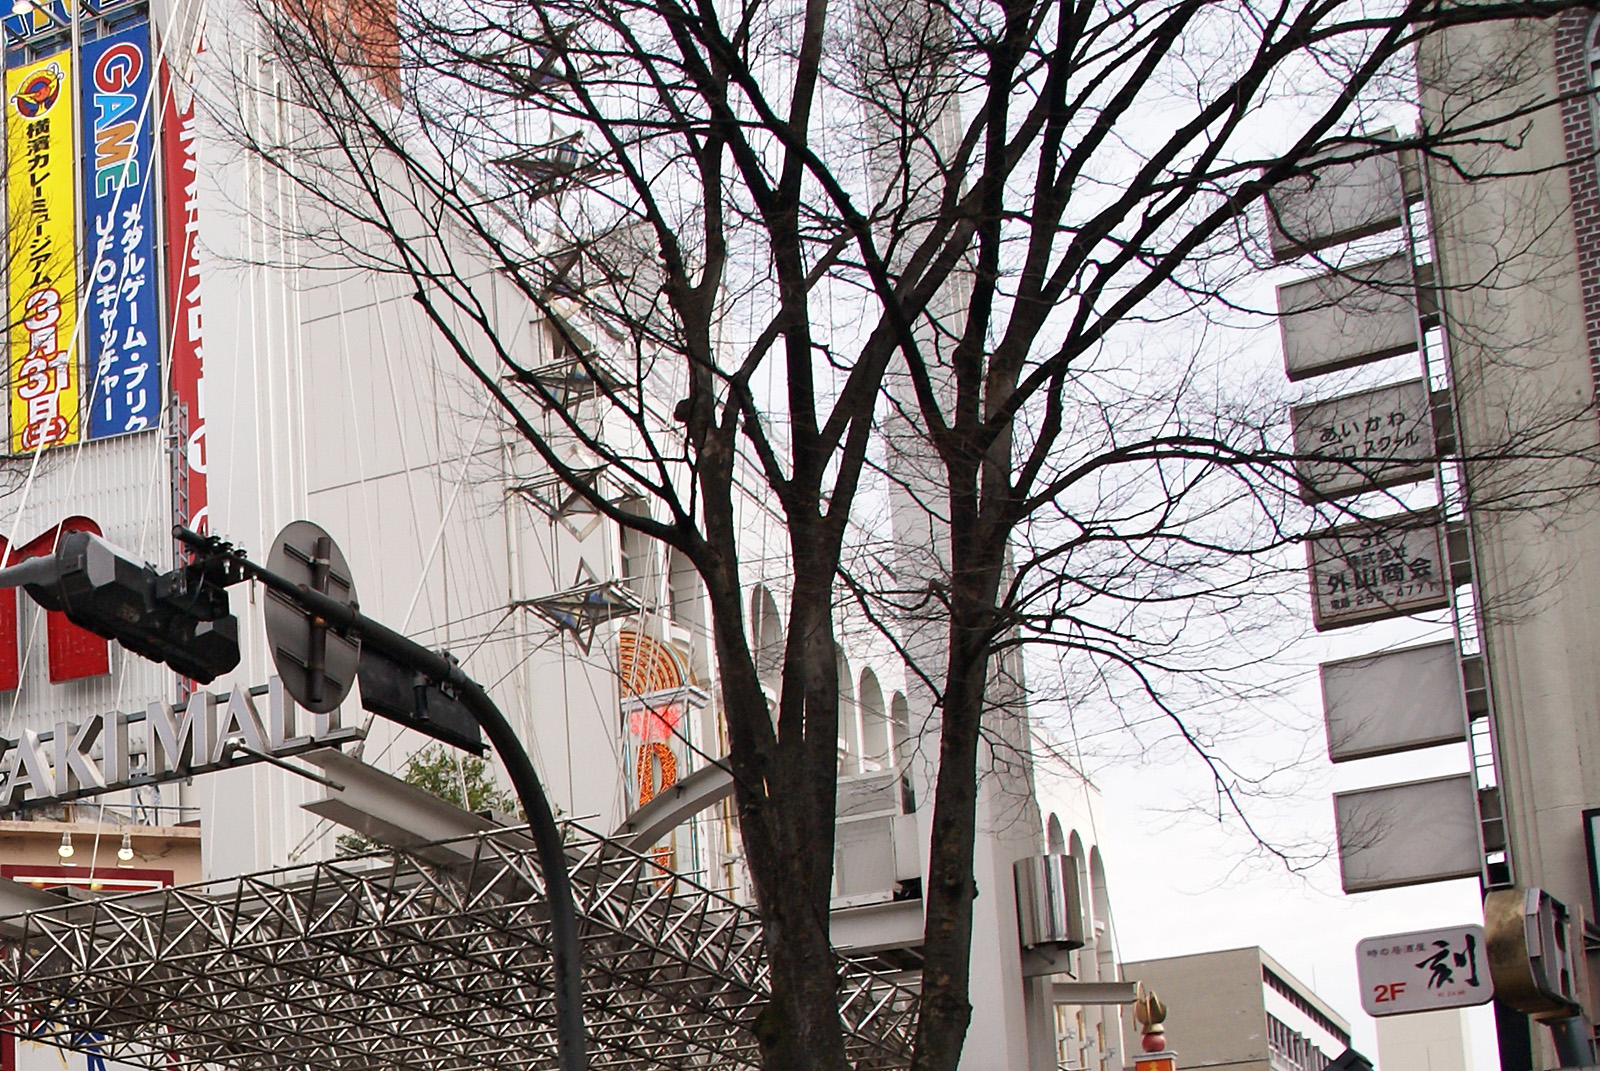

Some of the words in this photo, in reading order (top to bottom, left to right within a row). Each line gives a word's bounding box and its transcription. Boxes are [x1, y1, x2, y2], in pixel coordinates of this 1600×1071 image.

[93, 42, 143, 198] GAME
[26, 118, 53, 289] 横濱カレーミュージアム
[1373, 982, 1407, 1003] 2F
